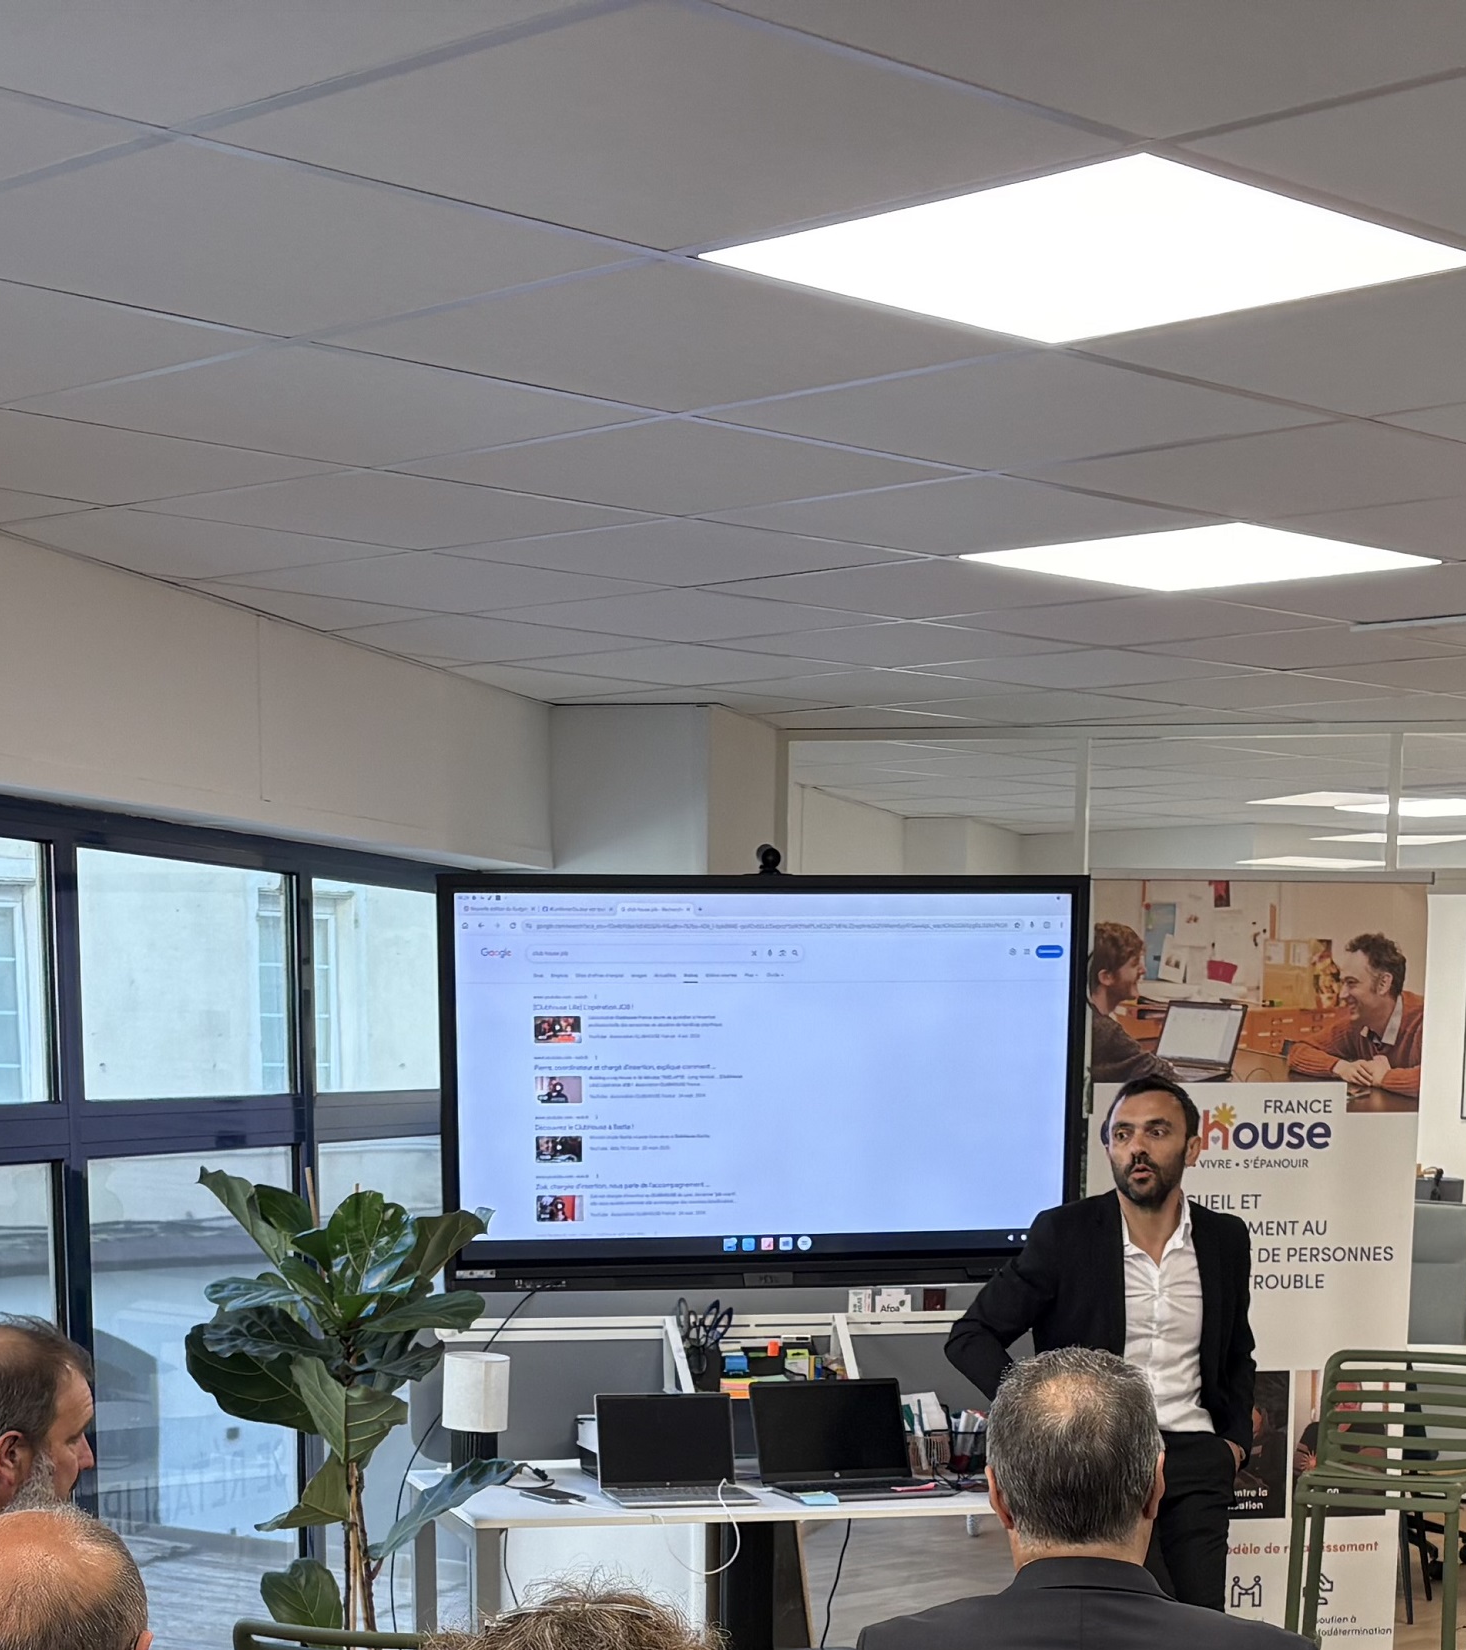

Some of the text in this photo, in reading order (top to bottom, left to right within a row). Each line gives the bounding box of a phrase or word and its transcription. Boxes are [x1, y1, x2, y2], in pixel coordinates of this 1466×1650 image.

[480, 947, 512, 959] Google
[1263, 1099, 1333, 1115] FRANCE
[1199, 1156, 1309, 1169] VIVRE S'ÉPANOUIR
[1241, 1194, 1261, 1209] ET
[1245, 1220, 1328, 1236] MENT AU
[1257, 1246, 1394, 1263] DE PERSONNES
[1258, 1487, 1268, 1497] la
[1264, 1542, 1280, 1555] de
[1317, 1616, 1348, 1625] outien
